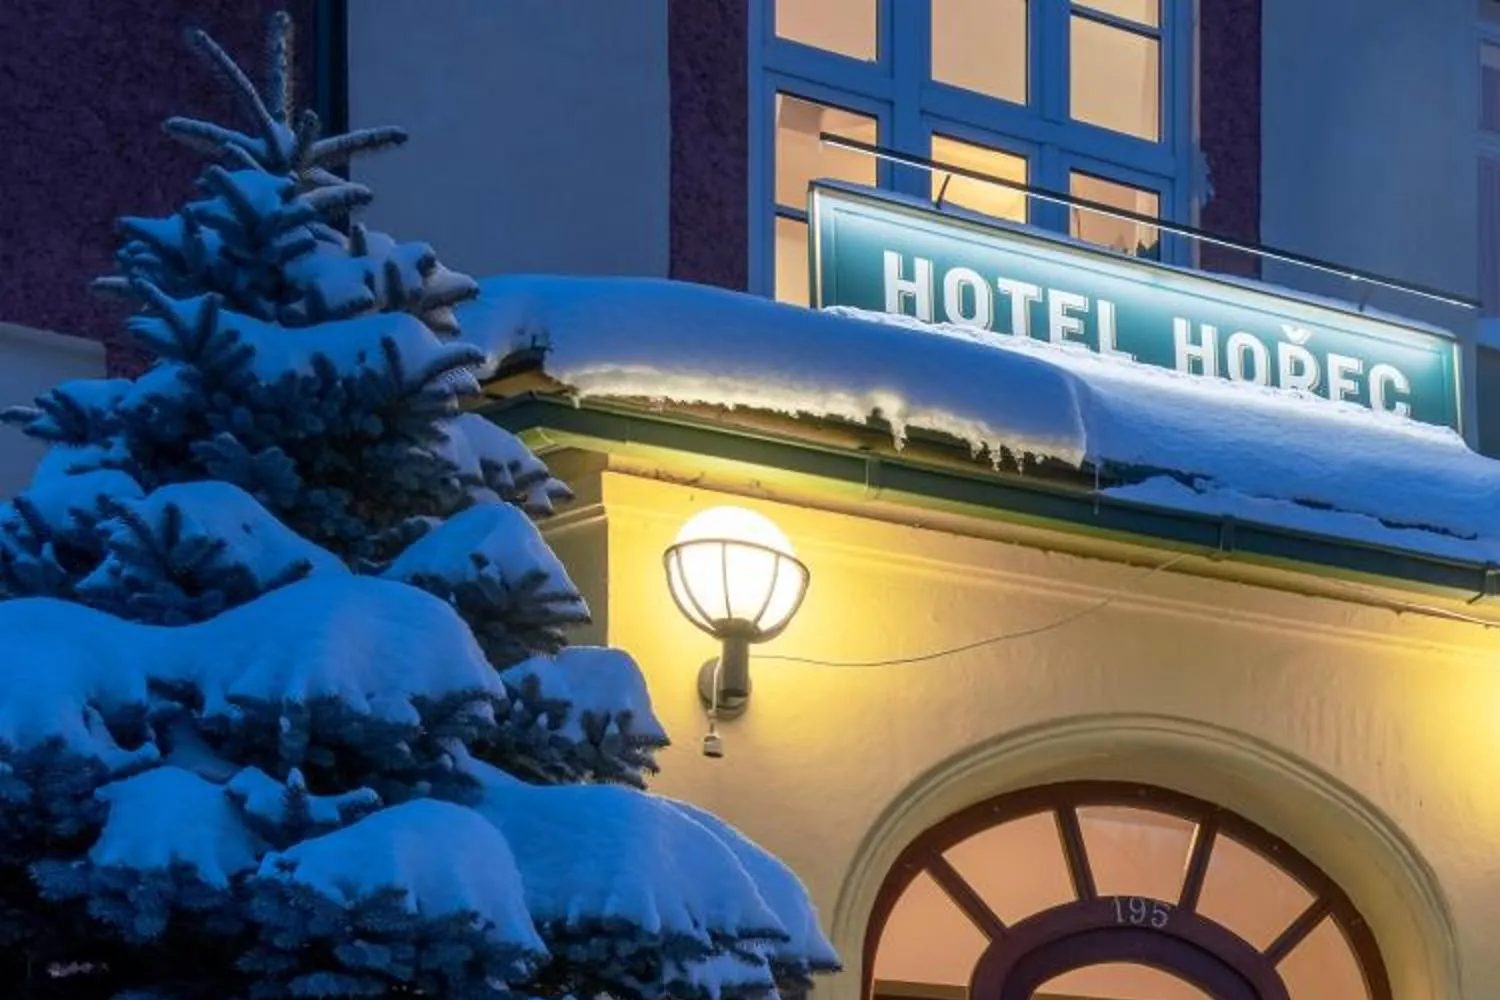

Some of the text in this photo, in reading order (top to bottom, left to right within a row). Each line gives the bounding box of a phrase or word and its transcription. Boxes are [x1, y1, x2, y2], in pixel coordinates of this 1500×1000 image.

[884, 249, 1412, 419] HOTEL HOŘEC
[1113, 896, 1169, 928] 195
